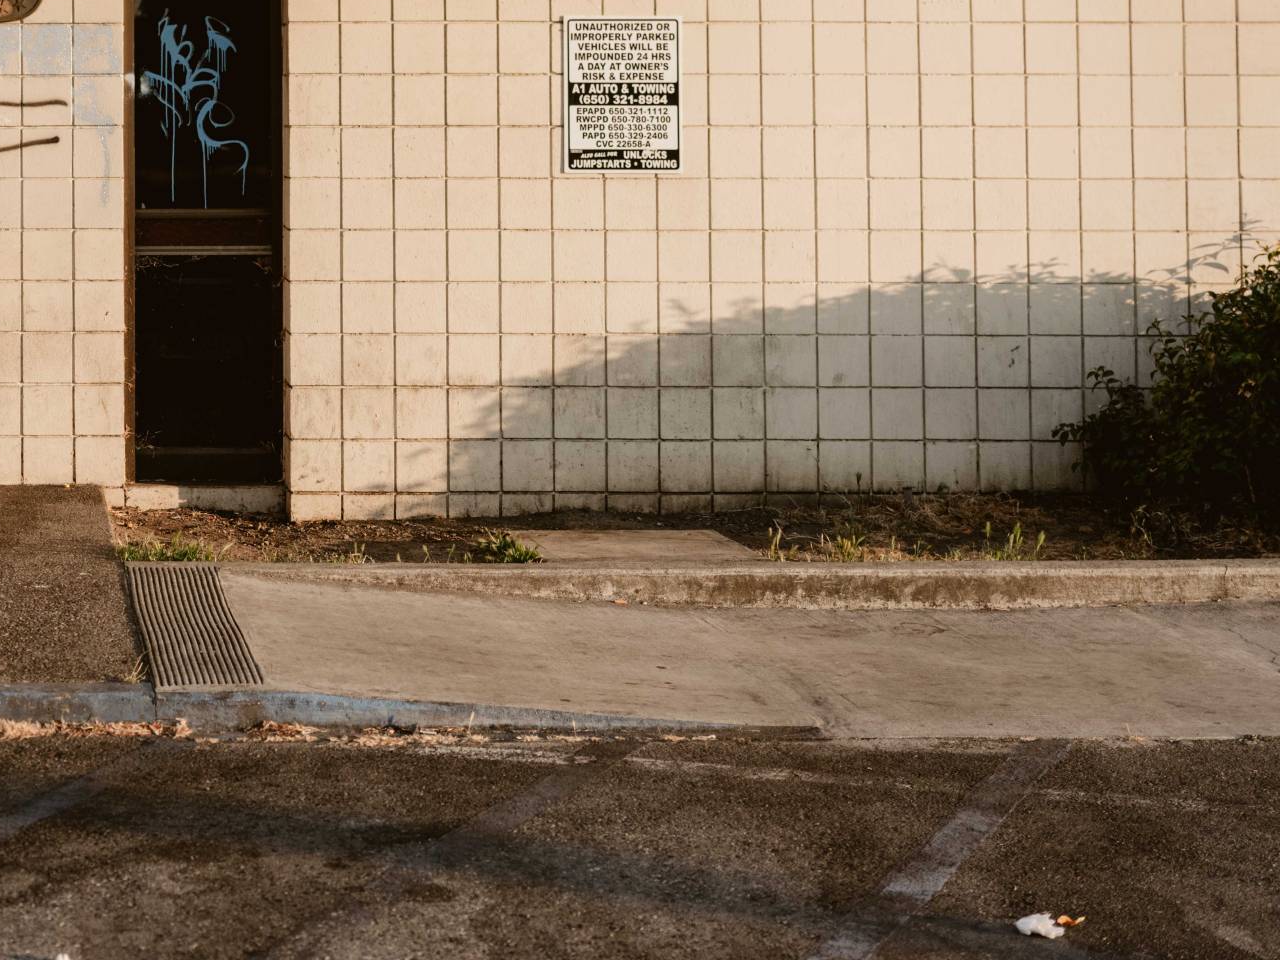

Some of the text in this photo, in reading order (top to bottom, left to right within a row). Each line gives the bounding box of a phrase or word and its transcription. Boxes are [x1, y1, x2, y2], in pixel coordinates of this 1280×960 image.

[575, 23, 670, 31] UNAUTHORIZED OR
[571, 33, 632, 41] IMPROPERLY
[578, 43, 626, 51] VEHICLES
[629, 43, 652, 51] WILL
[574, 53, 634, 61] IMPOUNDED
[572, 84, 675, 94] A1 AUTO & TOWING
[579, 95, 668, 104] (650) 321-8984
[623, 150, 667, 159] UNLOCKS
[571, 160, 677, 168] JUMPSTARTS TOWING
